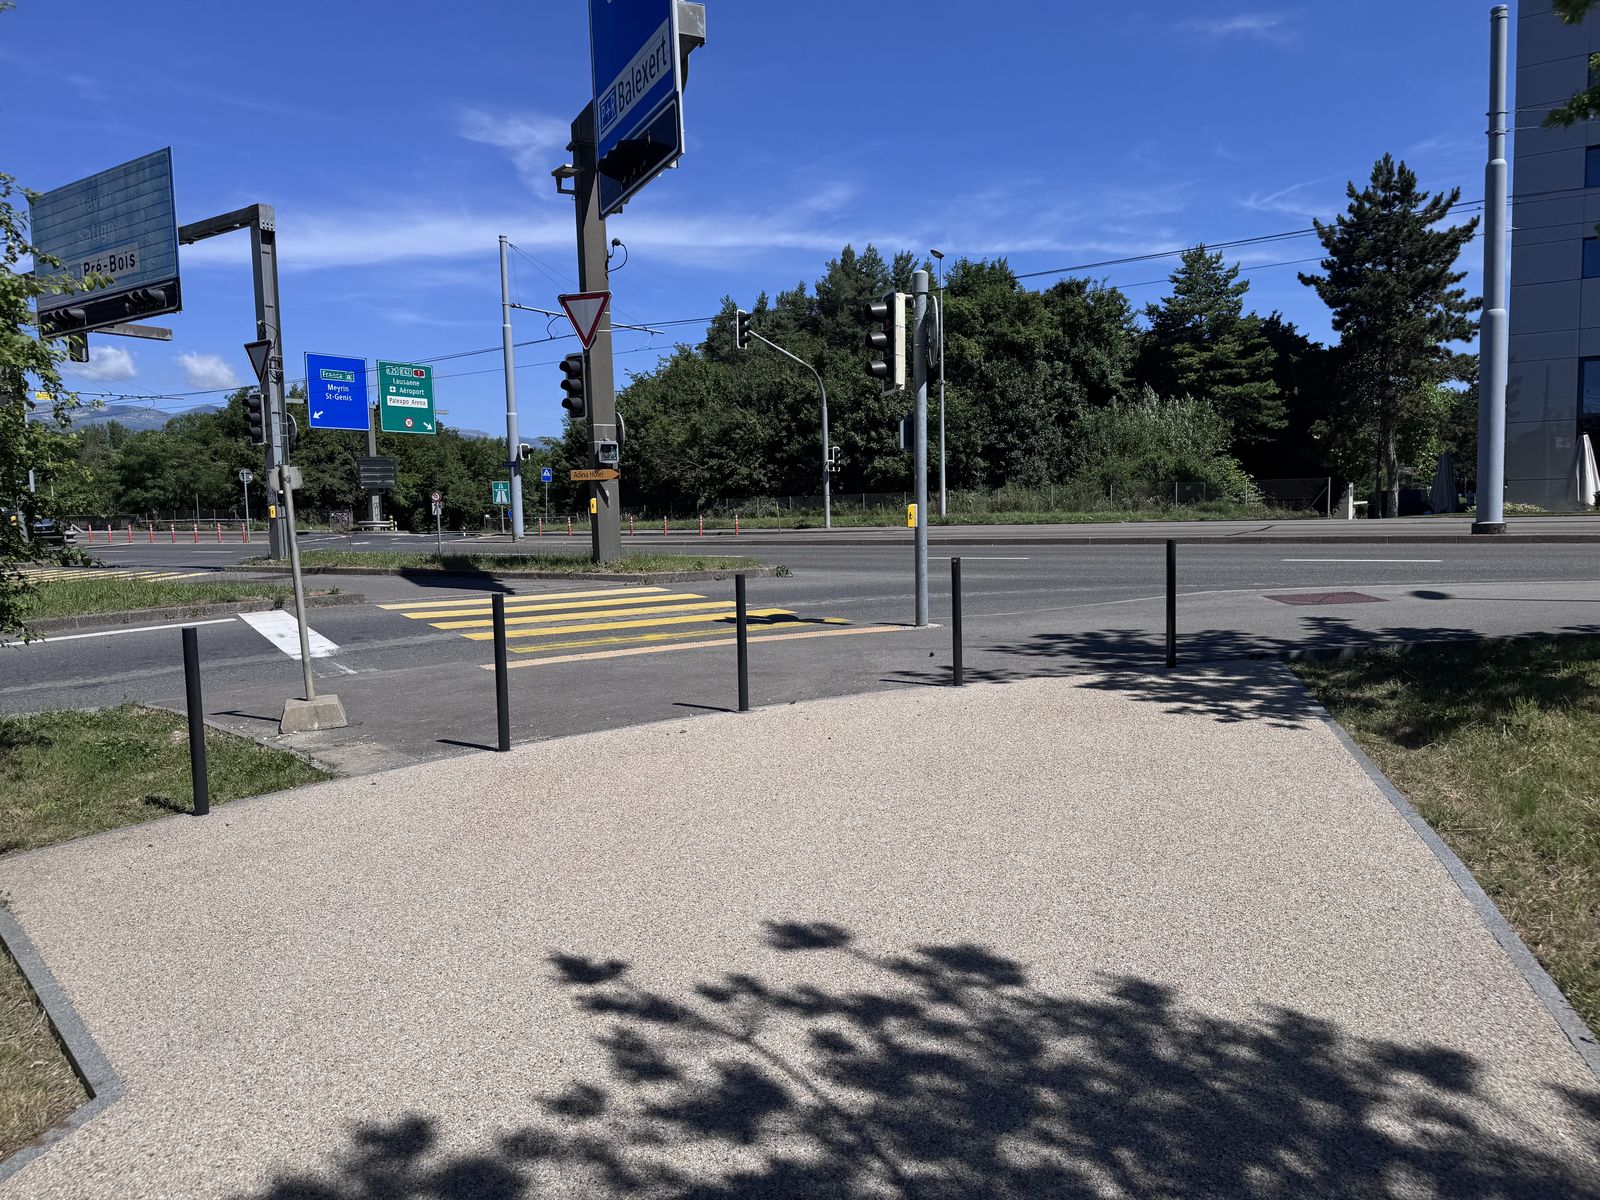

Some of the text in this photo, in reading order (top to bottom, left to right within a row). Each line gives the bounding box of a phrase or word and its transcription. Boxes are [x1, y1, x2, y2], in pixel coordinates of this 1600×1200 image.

[618, 37, 668, 113] Balexert
[83, 251, 136, 275] Pré-Bois
[322, 370, 343, 380] France
[392, 377, 420, 387] Lausanne
[327, 383, 350, 393] Meyrin
[399, 387, 425, 396] Aéroport
[325, 392, 352, 402] St-Genis
[389, 397, 410, 405] Palexpo
